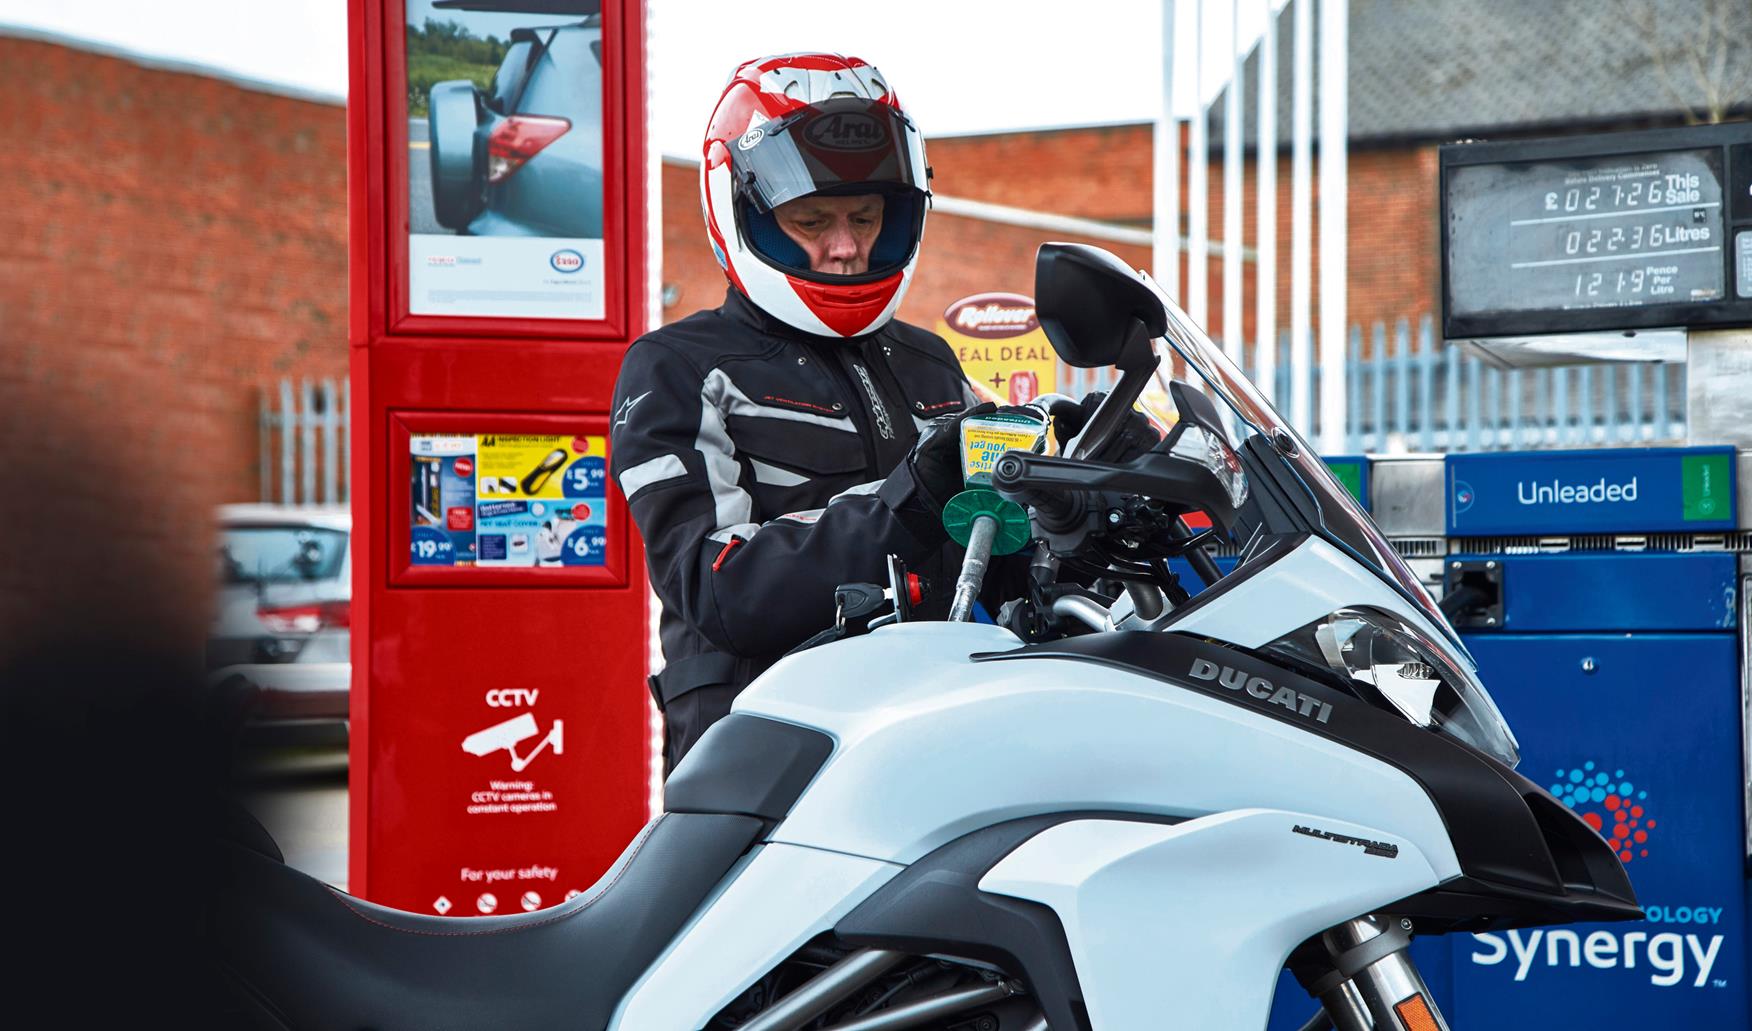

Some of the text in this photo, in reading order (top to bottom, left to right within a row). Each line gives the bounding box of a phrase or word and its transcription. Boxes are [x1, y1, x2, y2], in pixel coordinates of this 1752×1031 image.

[1665, 172, 1700, 191] This
[1665, 188, 1700, 205] Sale
[1665, 226, 1710, 244] Litres
[1646, 265, 1679, 276] Pence
[1653, 275, 1672, 285] Per
[1650, 284, 1674, 295] Litre
[959, 345, 1050, 362] EAL DEAL
[970, 440, 1006, 452] you get
[1517, 476, 1638, 505] Unleaded
[485, 688, 540, 708] CCTV
[1188, 657, 1334, 724] DUCATI
[471, 791, 553, 803] CCTV cameras in
[467, 801, 557, 814] constant operation
[460, 864, 559, 884] For your safety
[1640, 904, 1723, 925] OLOGY
[1471, 928, 1725, 988] Synergy
